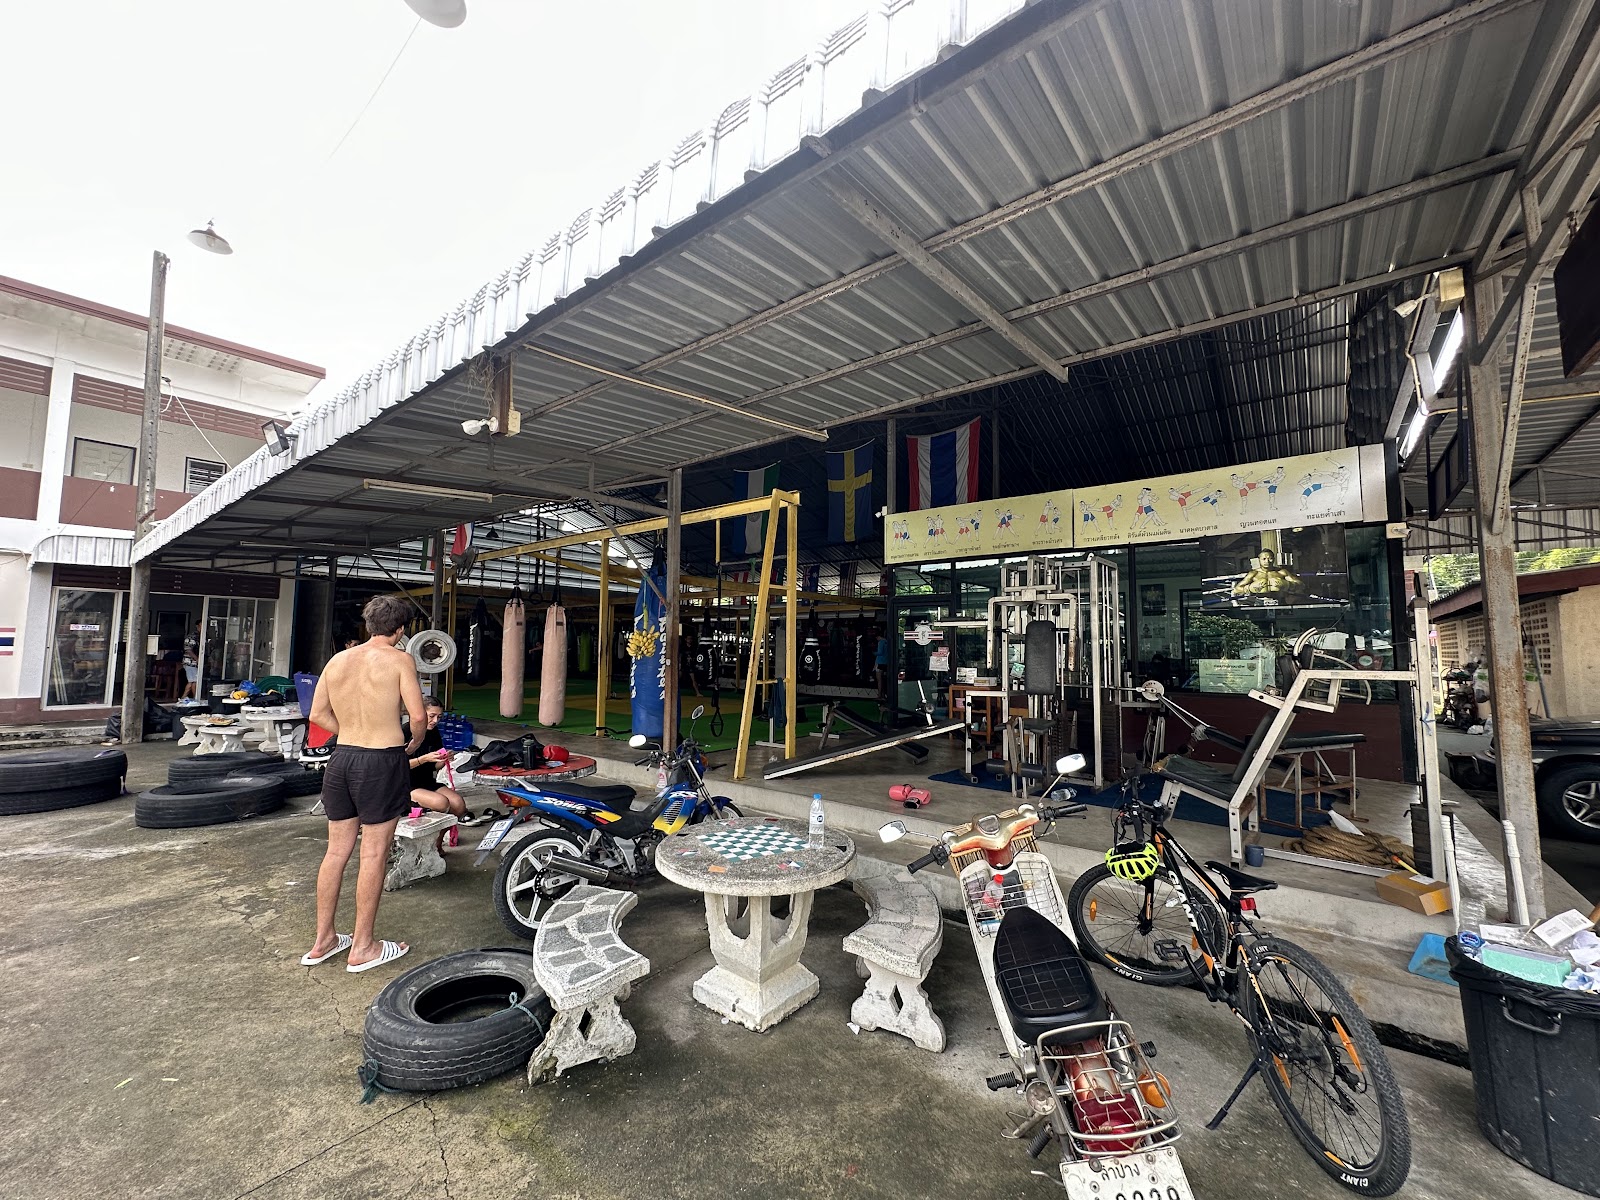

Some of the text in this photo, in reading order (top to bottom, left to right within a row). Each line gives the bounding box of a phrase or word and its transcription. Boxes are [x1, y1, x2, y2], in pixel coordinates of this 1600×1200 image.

[536, 796, 588, 811] Sonic
[1112, 965, 1143, 982] GIANT
[1100, 1162, 1141, 1182] ลำปาง
[1340, 1172, 1369, 1187] GIANT
